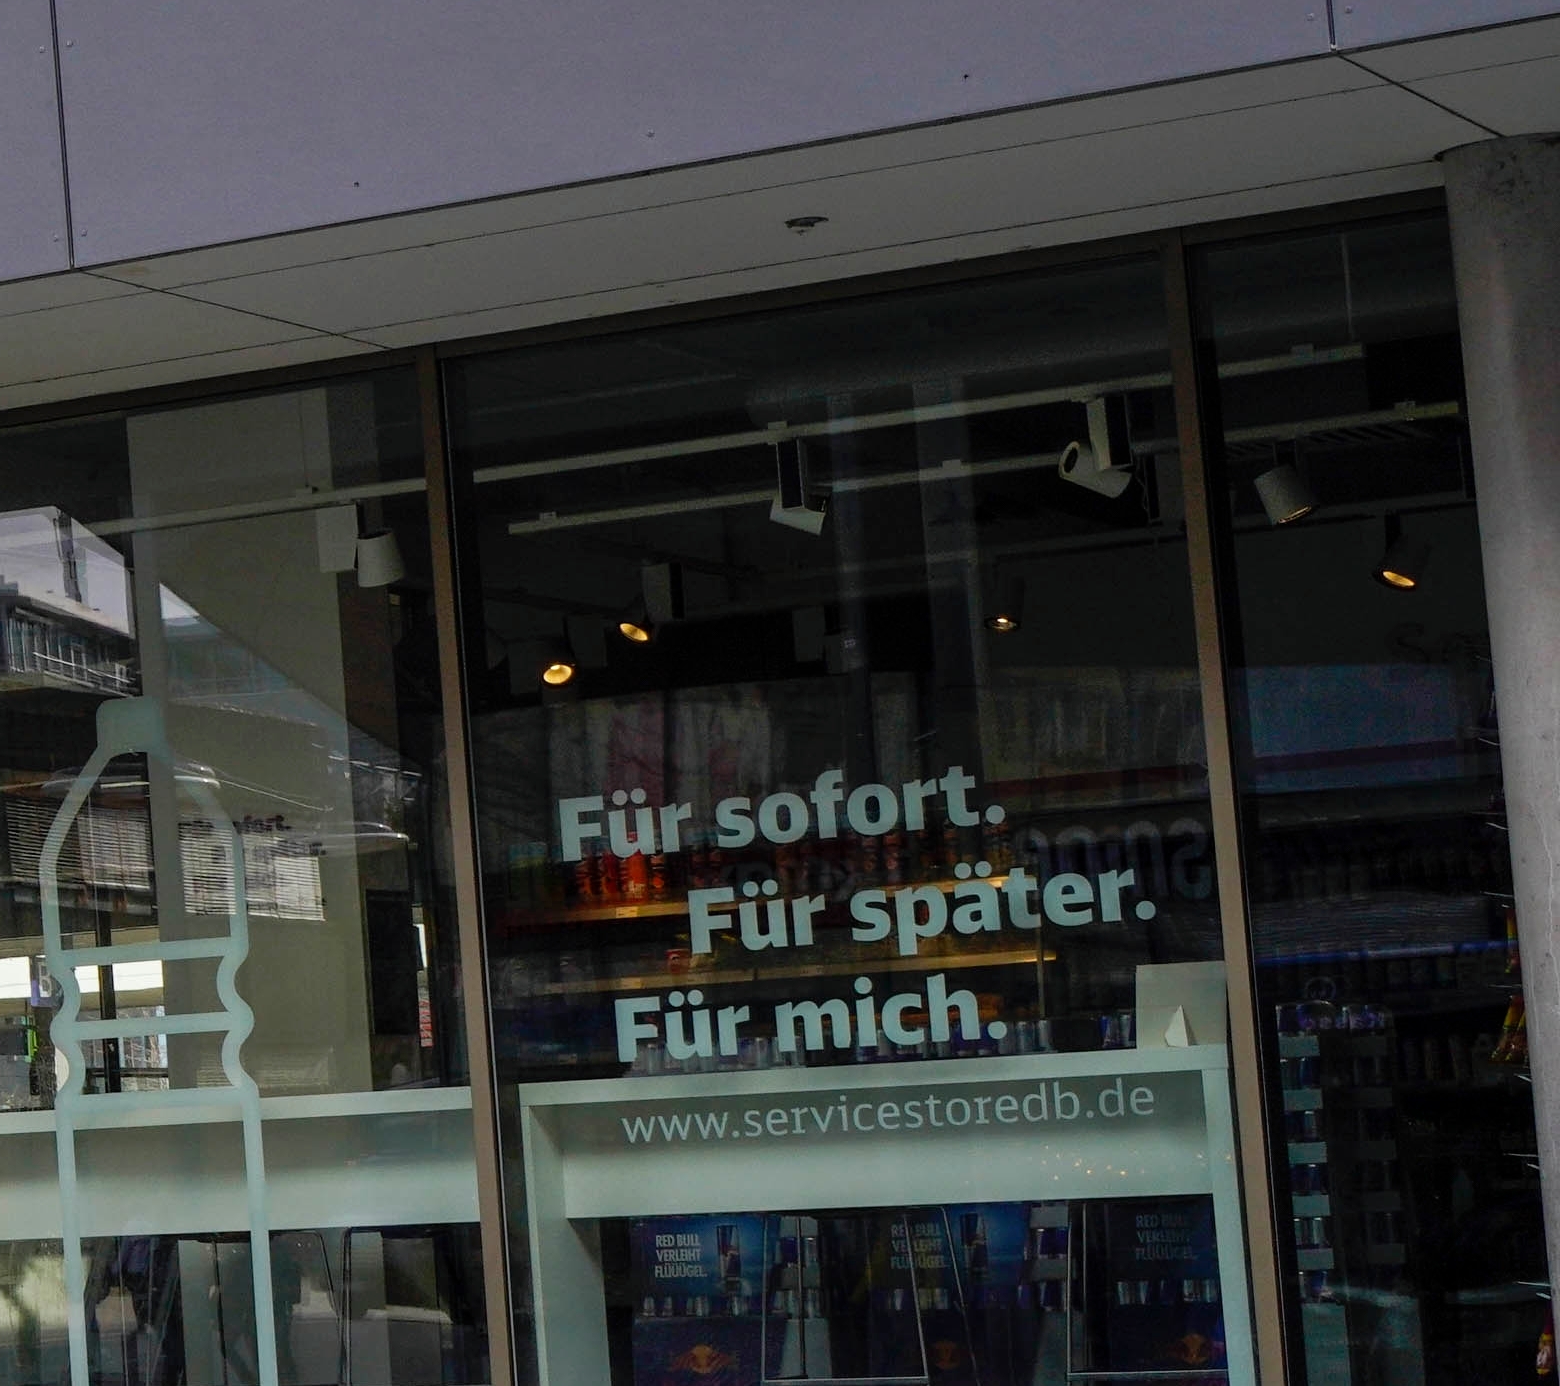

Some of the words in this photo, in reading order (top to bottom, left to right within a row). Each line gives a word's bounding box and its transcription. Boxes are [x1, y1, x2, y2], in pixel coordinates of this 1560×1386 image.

[558, 788, 692, 862] Für
[716, 766, 1006, 849] sofort.
[687, 879, 826, 955] Für
[851, 860, 1156, 956] später.
[614, 989, 750, 1063] Für
[775, 973, 1008, 1053] mich.
[621, 1078, 1155, 1144] www.servicestoredb.de
[655, 1234, 675, 1248] RED
[676, 1233, 700, 1247] BULL
[655, 1248, 702, 1262] VERLEIHT
